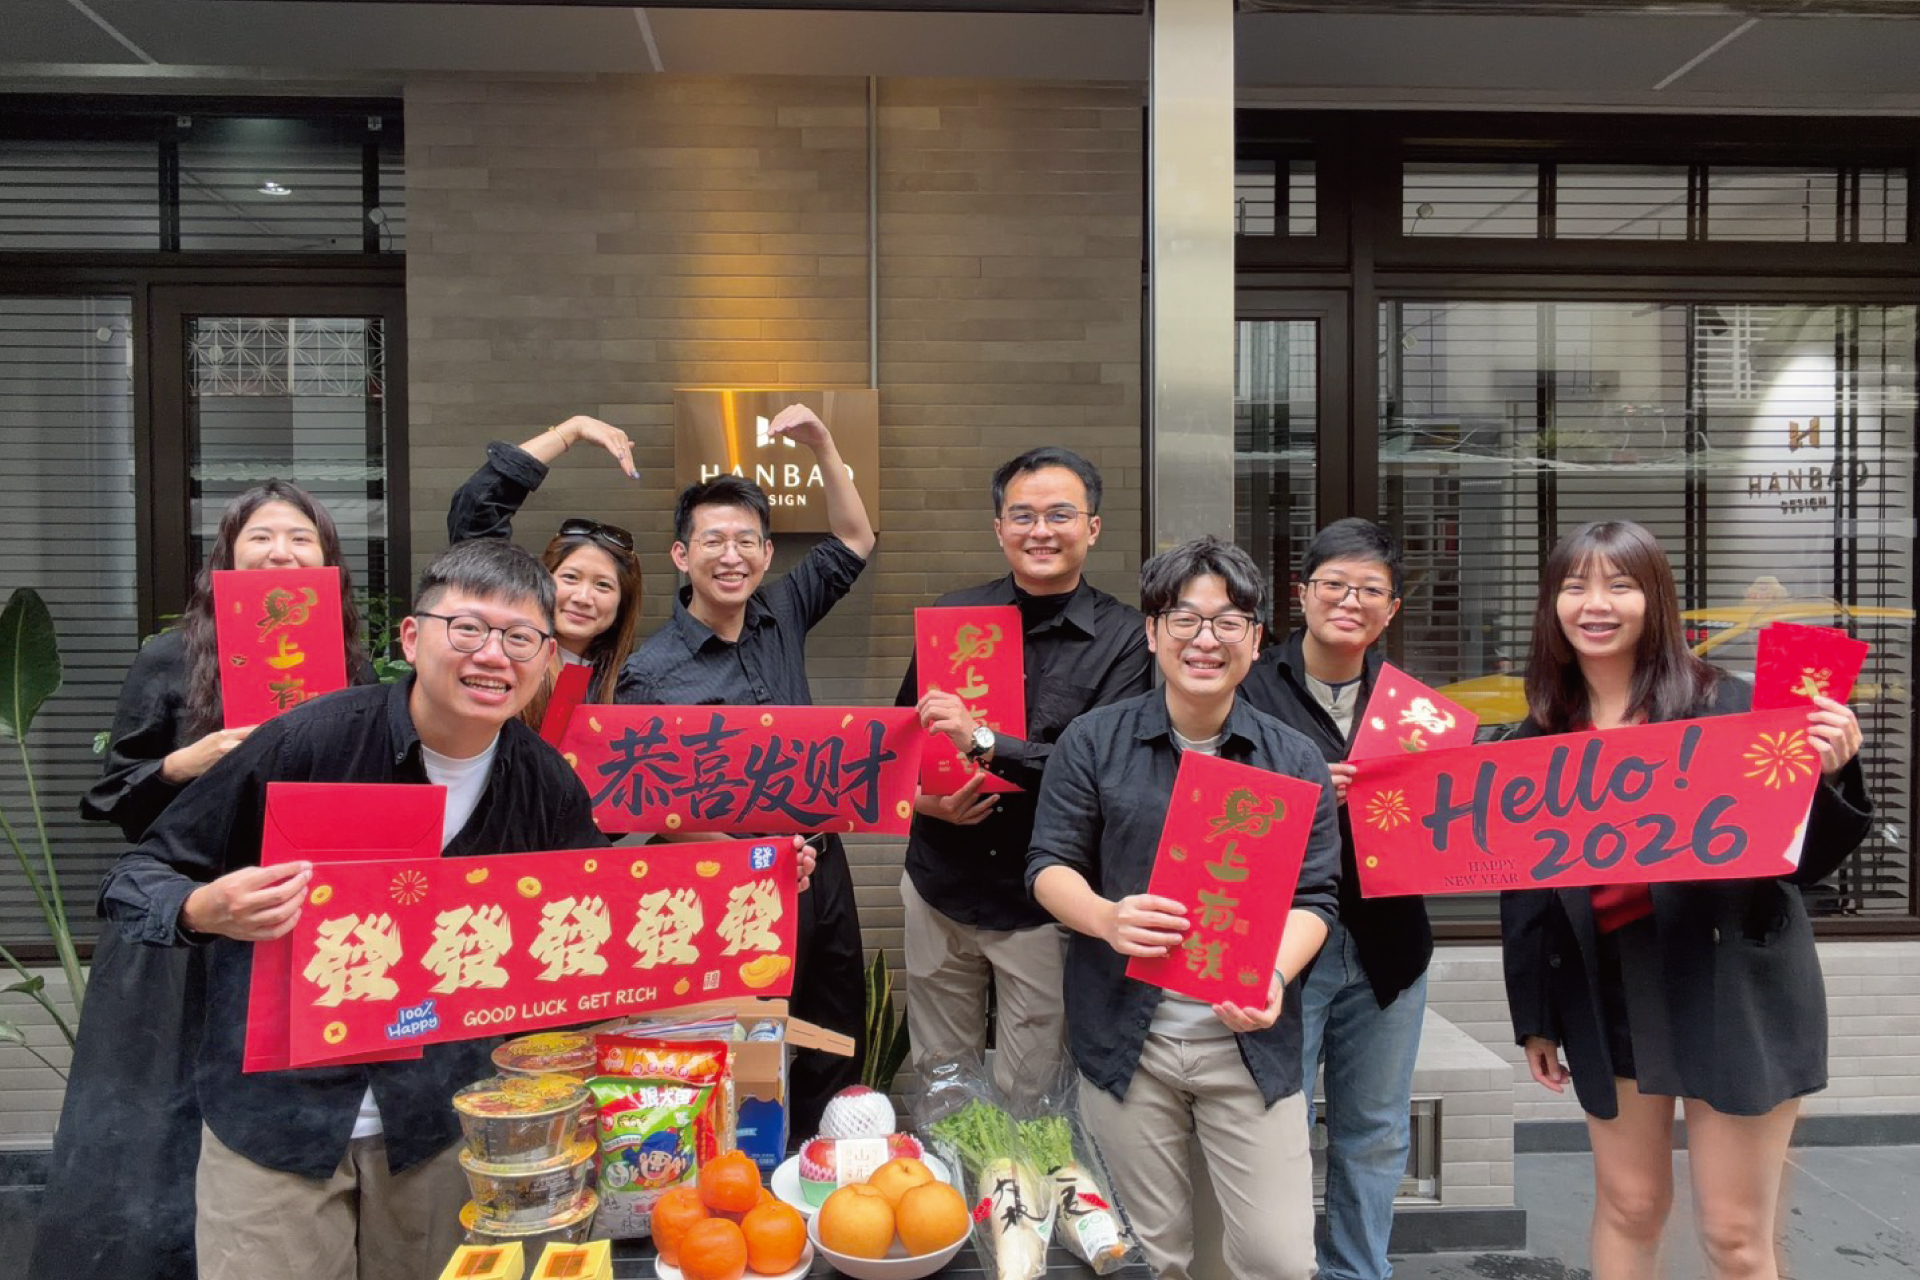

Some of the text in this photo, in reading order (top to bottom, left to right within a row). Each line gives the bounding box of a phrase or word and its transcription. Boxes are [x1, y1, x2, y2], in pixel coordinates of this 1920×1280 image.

[768, 494, 807, 506] SIGN
[591, 712, 898, 827] 恭喜发财
[1421, 725, 1704, 856] Hello!
[1530, 795, 1748, 881] 2026
[1468, 859, 1515, 872] HAPPY
[1444, 873, 1519, 887] NEW YEAR
[400, 1001, 434, 1022] 100%
[463, 987, 658, 1027] GOOD LUCK GET RICH
[387, 1015, 438, 1038] Happy
